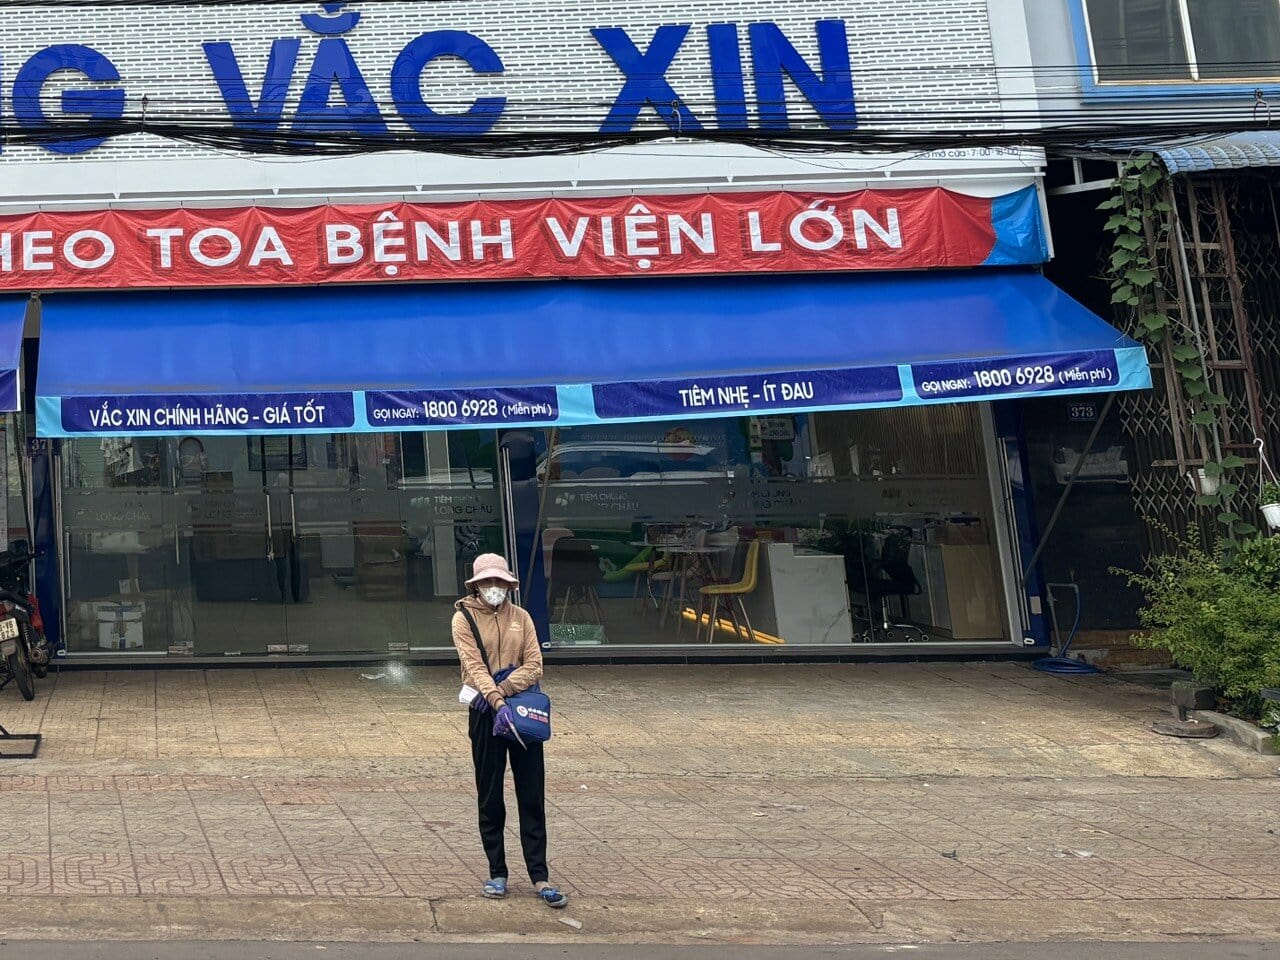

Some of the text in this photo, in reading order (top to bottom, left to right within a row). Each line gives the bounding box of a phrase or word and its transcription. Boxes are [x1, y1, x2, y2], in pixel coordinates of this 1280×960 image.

[590, 19, 858, 134] XIN
[146, 226, 294, 269] TOA
[325, 210, 514, 275] BỆNH
[546, 203, 717, 270] VIỆN
[748, 200, 903, 253] LỚN
[678, 384, 715, 408] TIÊM
[717, 386, 749, 410] NHẸ
[762, 378, 778, 403] ÍT
[780, 381, 814, 402] ĐAU
[921, 379, 941, 394] GỌI
[941, 378, 972, 393] NGAY:
[973, 369, 1012, 390] 1800
[1016, 365, 1055, 386] 6928
[89, 401, 123, 427] VẮC
[125, 408, 152, 427] XIN
[154, 401, 201, 426] CHÍNH
[203, 401, 249, 425] HÃNG
[263, 401, 291, 424] GIÁ
[292, 397, 326, 423] TỐT
[373, 408, 392, 422] GỌI
[393, 407, 420, 421] NGAY:
[423, 400, 457, 419] 1800
[462, 398, 498, 417] 6928
[1071, 406, 1094, 418] 373
